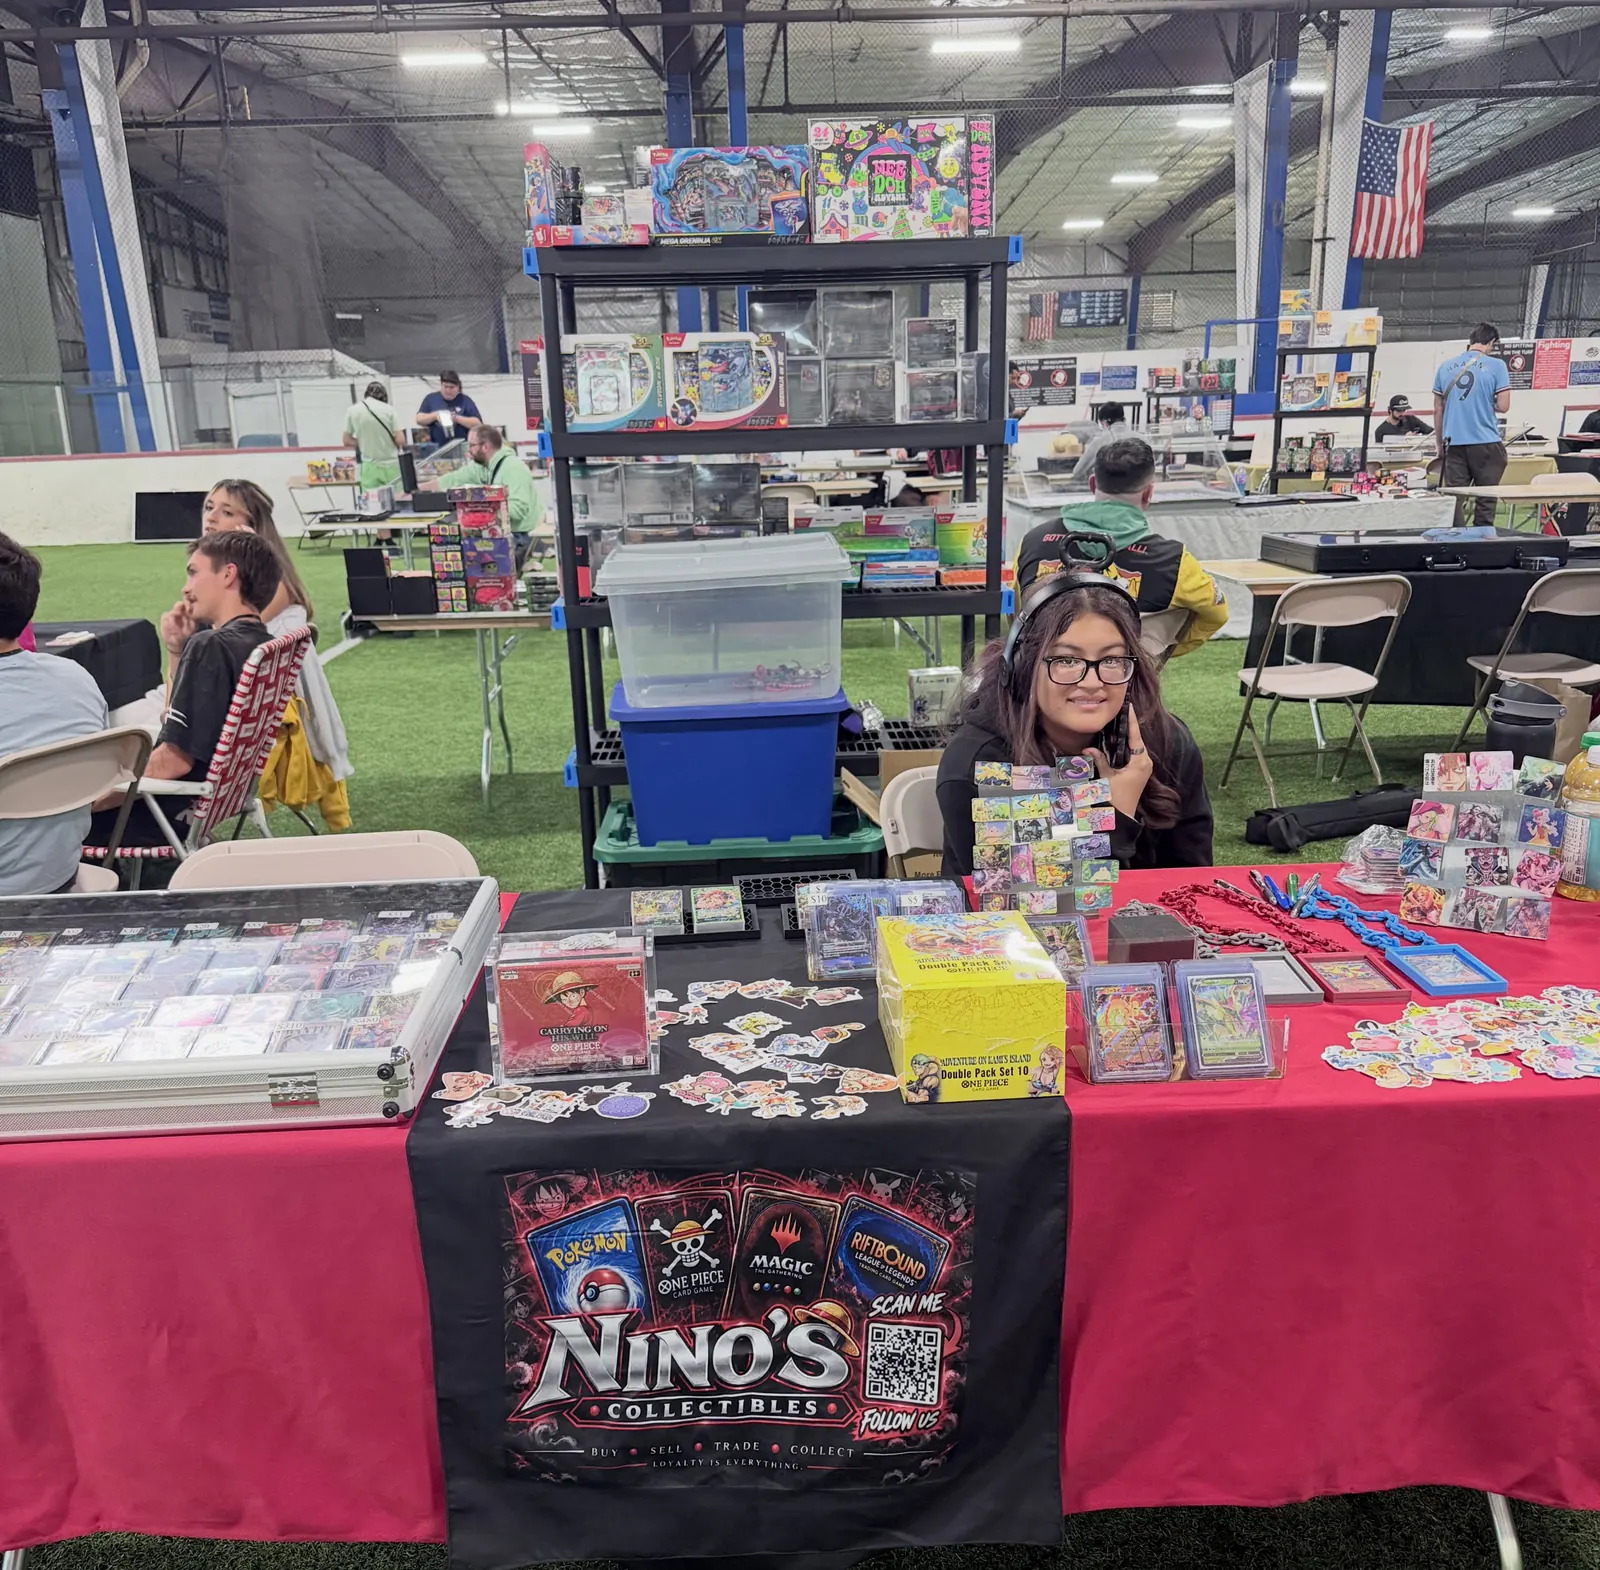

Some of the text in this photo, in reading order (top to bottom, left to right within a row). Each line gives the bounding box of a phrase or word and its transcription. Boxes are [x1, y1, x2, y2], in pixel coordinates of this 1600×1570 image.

[872, 160, 907, 180] NEE
[873, 175, 906, 194] DOH
[970, 144, 991, 227] ADVENT
[1538, 340, 1571, 351] Fighting
[1456, 370, 1474, 401] 9
[811, 895, 828, 904] $10
[918, 962, 958, 970] Double
[540, 1024, 608, 1036] CARRYING ON
[551, 1032, 597, 1042] HIS WILL
[551, 1042, 601, 1053] ONE PIECE
[940, 1056, 977, 1066] ADVENTURE
[978, 1055, 987, 1065] ON
[1009, 1054, 1031, 1063] ISLAND
[941, 1066, 1029, 1079] Double Pack Set 10
[961, 1078, 1009, 1088] ONE PIECE
[749, 1254, 814, 1276] MAGIC
[851, 1231, 926, 1281] RIFTBOUND
[767, 1269, 803, 1280] GATHERING
[854, 1253, 881, 1268] LEAGUE
[884, 1265, 915, 1286] LEGENDS
[858, 1263, 906, 1289] TRADING CARD GAME
[658, 1269, 725, 1295] ONE PIECE
[672, 1285, 714, 1299] CARD GAME
[868, 1292, 946, 1317] SCAN ME
[520, 1308, 849, 1411] NINO'S
[607, 1399, 818, 1420] COLLECTIBLES
[860, 1408, 940, 1433] FOLLOW US
[591, 1441, 855, 1458] BUY SELL TRADE COLLECT
[653, 1458, 803, 1471] LOYALTY IS EVERYTHING.
